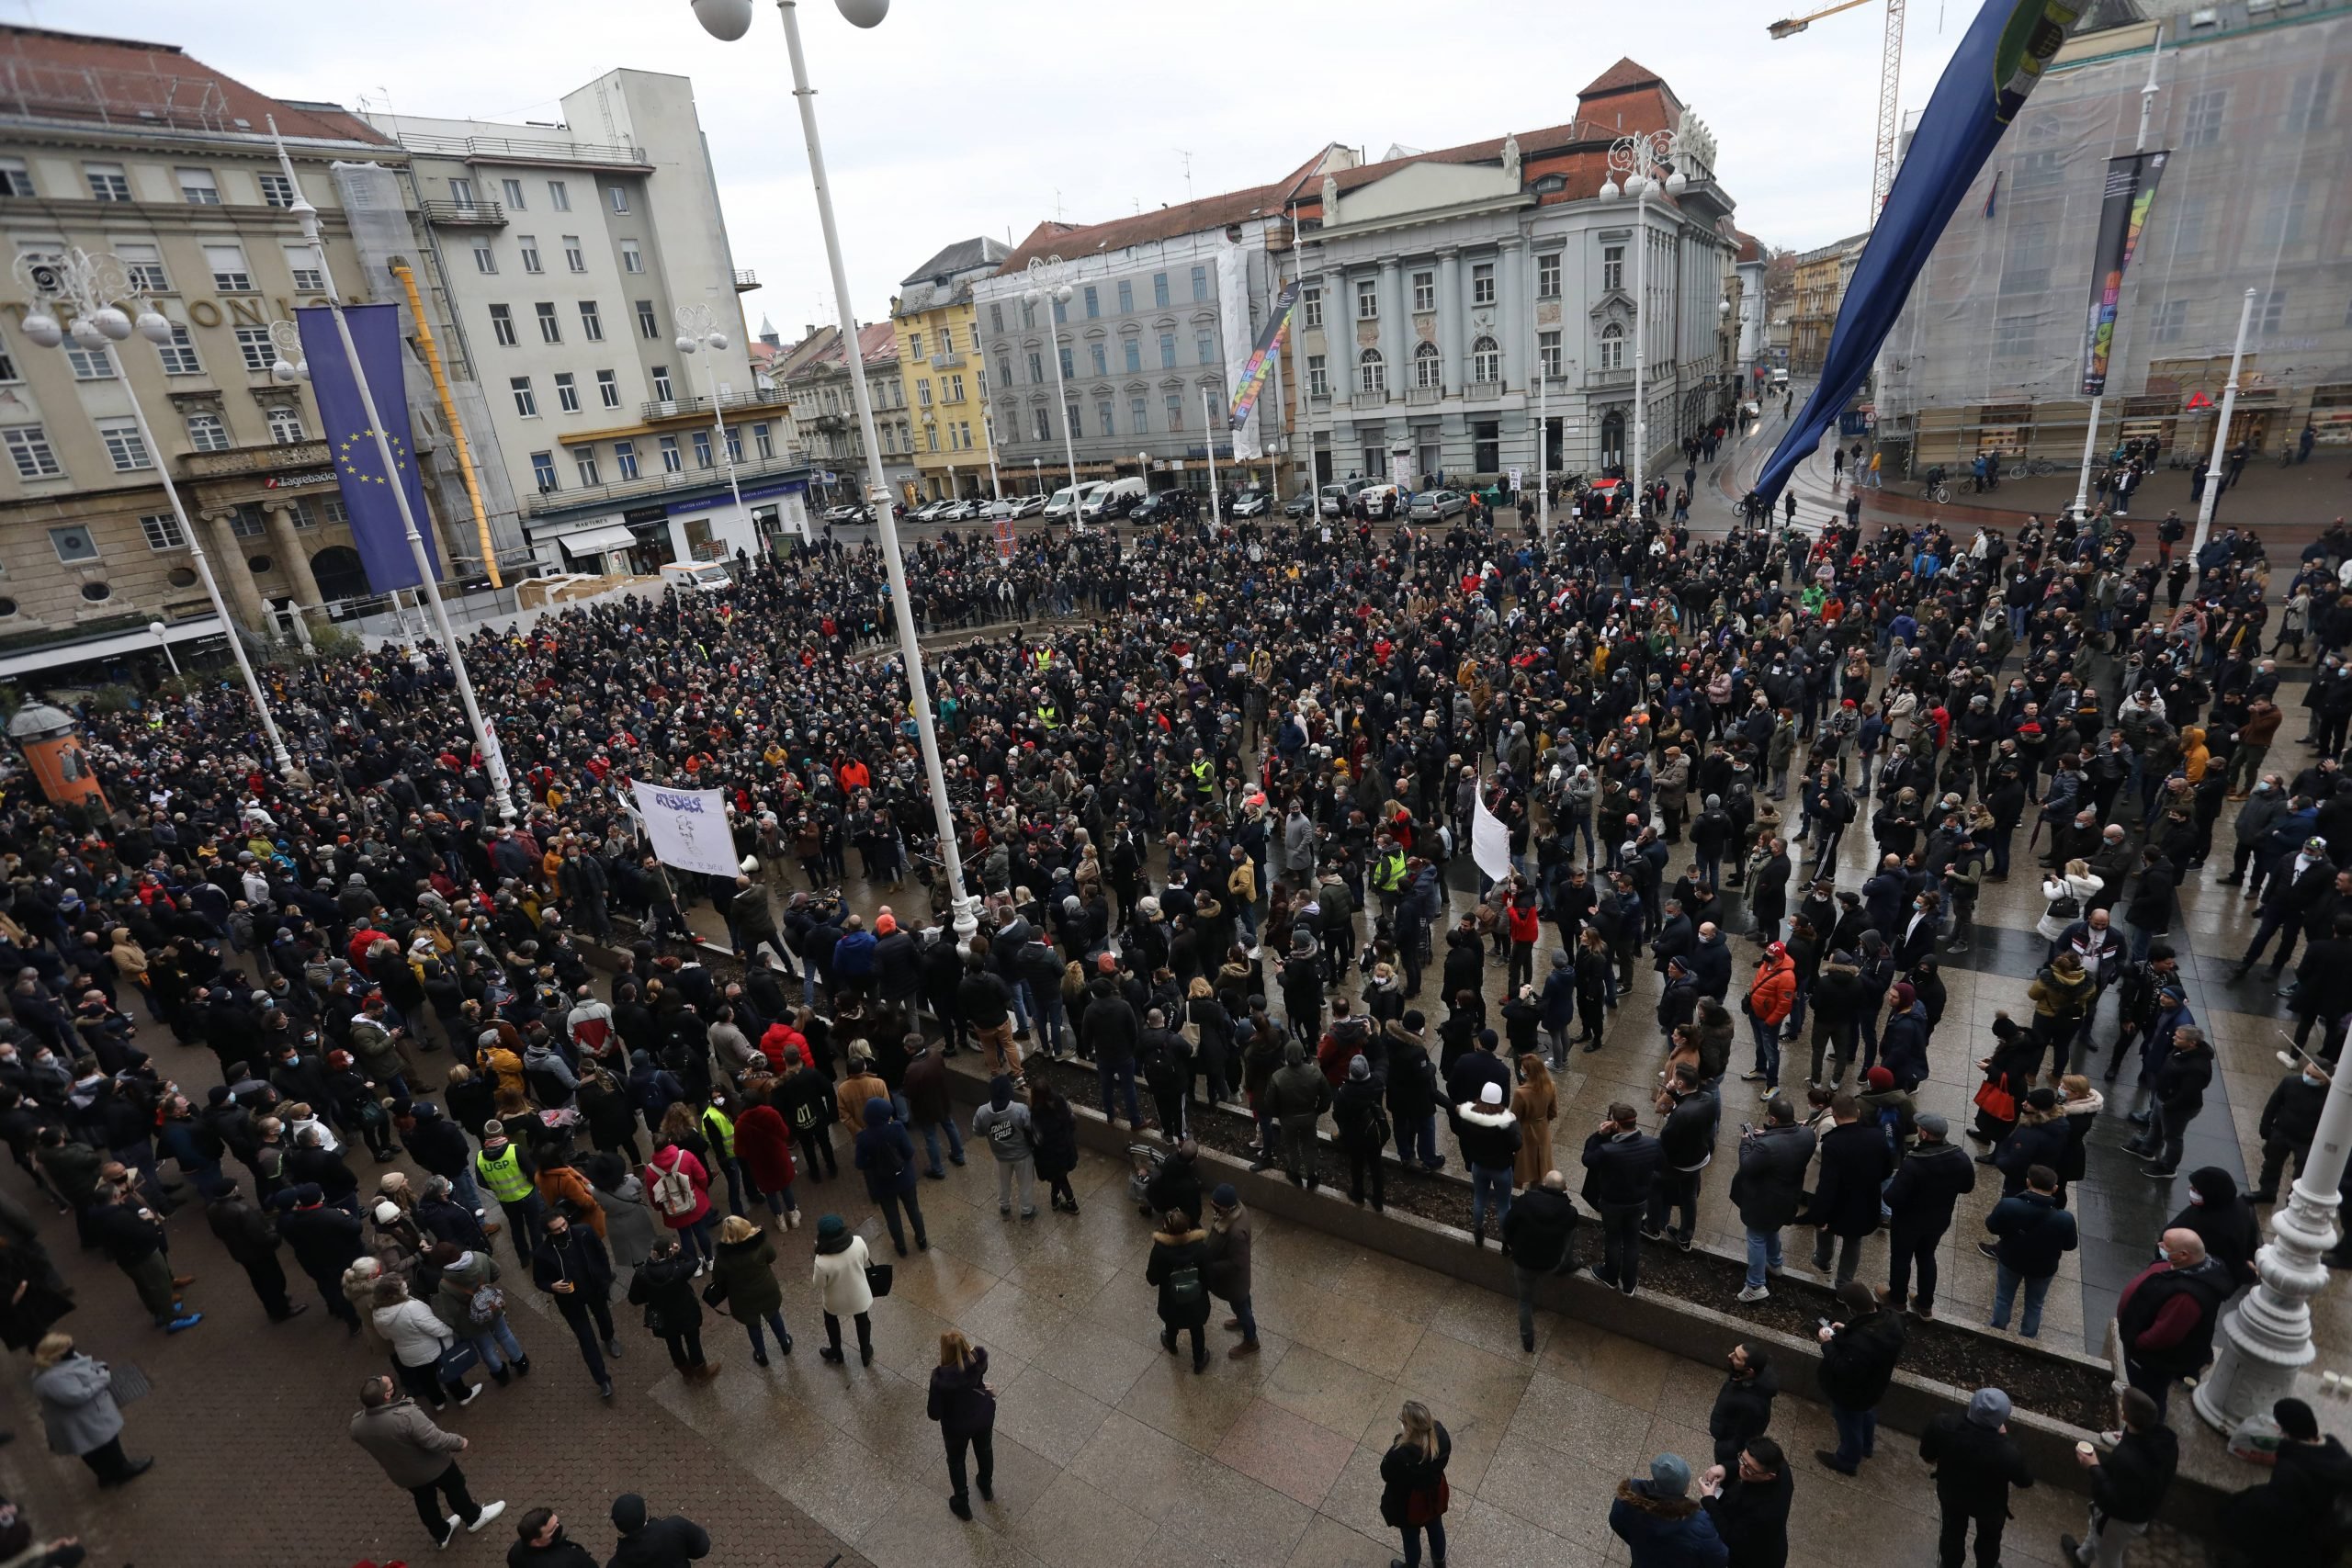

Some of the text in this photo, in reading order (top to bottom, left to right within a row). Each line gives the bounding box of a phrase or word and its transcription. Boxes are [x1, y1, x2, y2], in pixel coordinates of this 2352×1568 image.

[278, 471, 338, 488] Zagrebačka
[991, 1120, 1012, 1134] SANTA
[994, 1127, 1012, 1141] CRUZ
[484, 1159, 510, 1172] UGP
